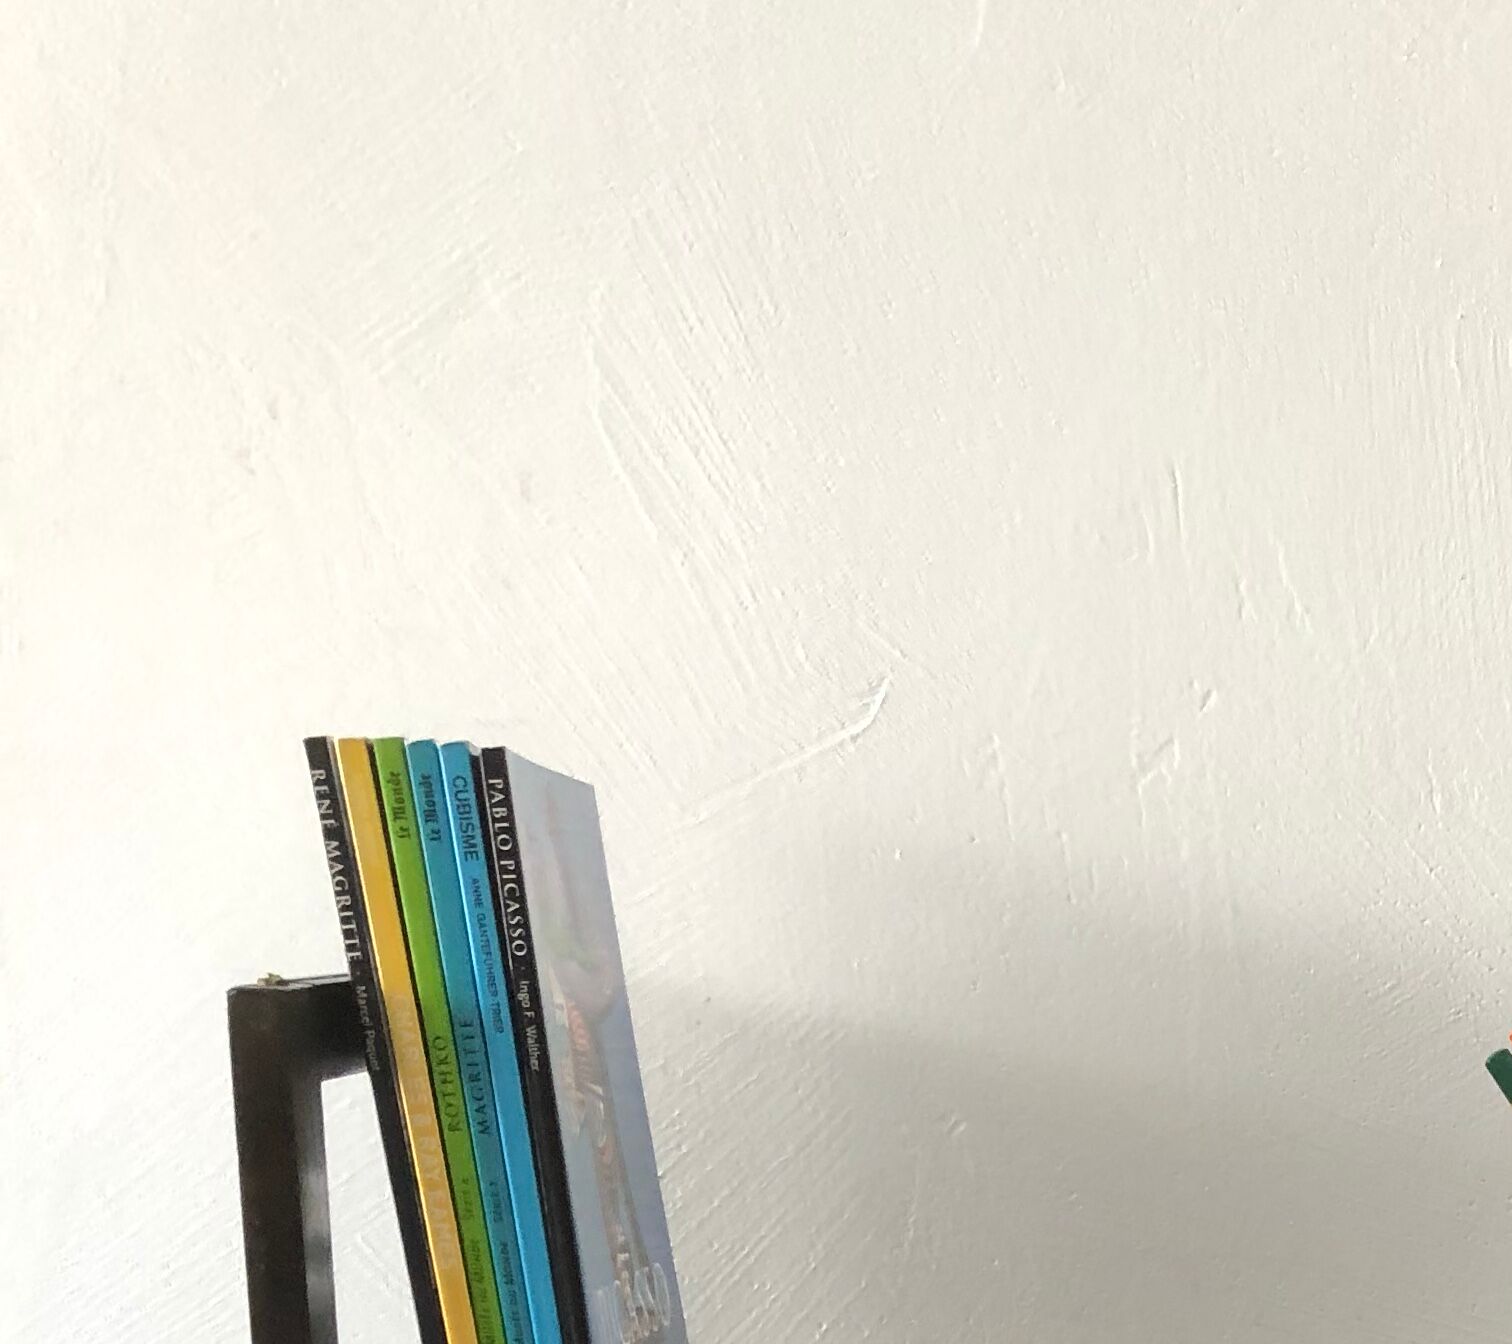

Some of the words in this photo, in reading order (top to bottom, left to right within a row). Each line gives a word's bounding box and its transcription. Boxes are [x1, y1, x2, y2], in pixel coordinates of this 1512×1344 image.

[386, 771, 408, 822] Monde
[419, 773, 439, 823] Monde
[452, 775, 480, 862] CUBISME
[488, 778, 512, 851] PABLO
[325, 840, 363, 962] MAGRITTE
[471, 878, 484, 908] ANNE
[499, 860, 528, 957] PICASSO
[355, 984, 372, 1026] Marcel
[517, 979, 531, 1009] Ingo
[524, 1024, 541, 1073] Walther
[363, 1029, 380, 1072] Paquet
[433, 1035, 463, 1132] ROTHKO
[460, 1021, 490, 1135] MAGRITTE
